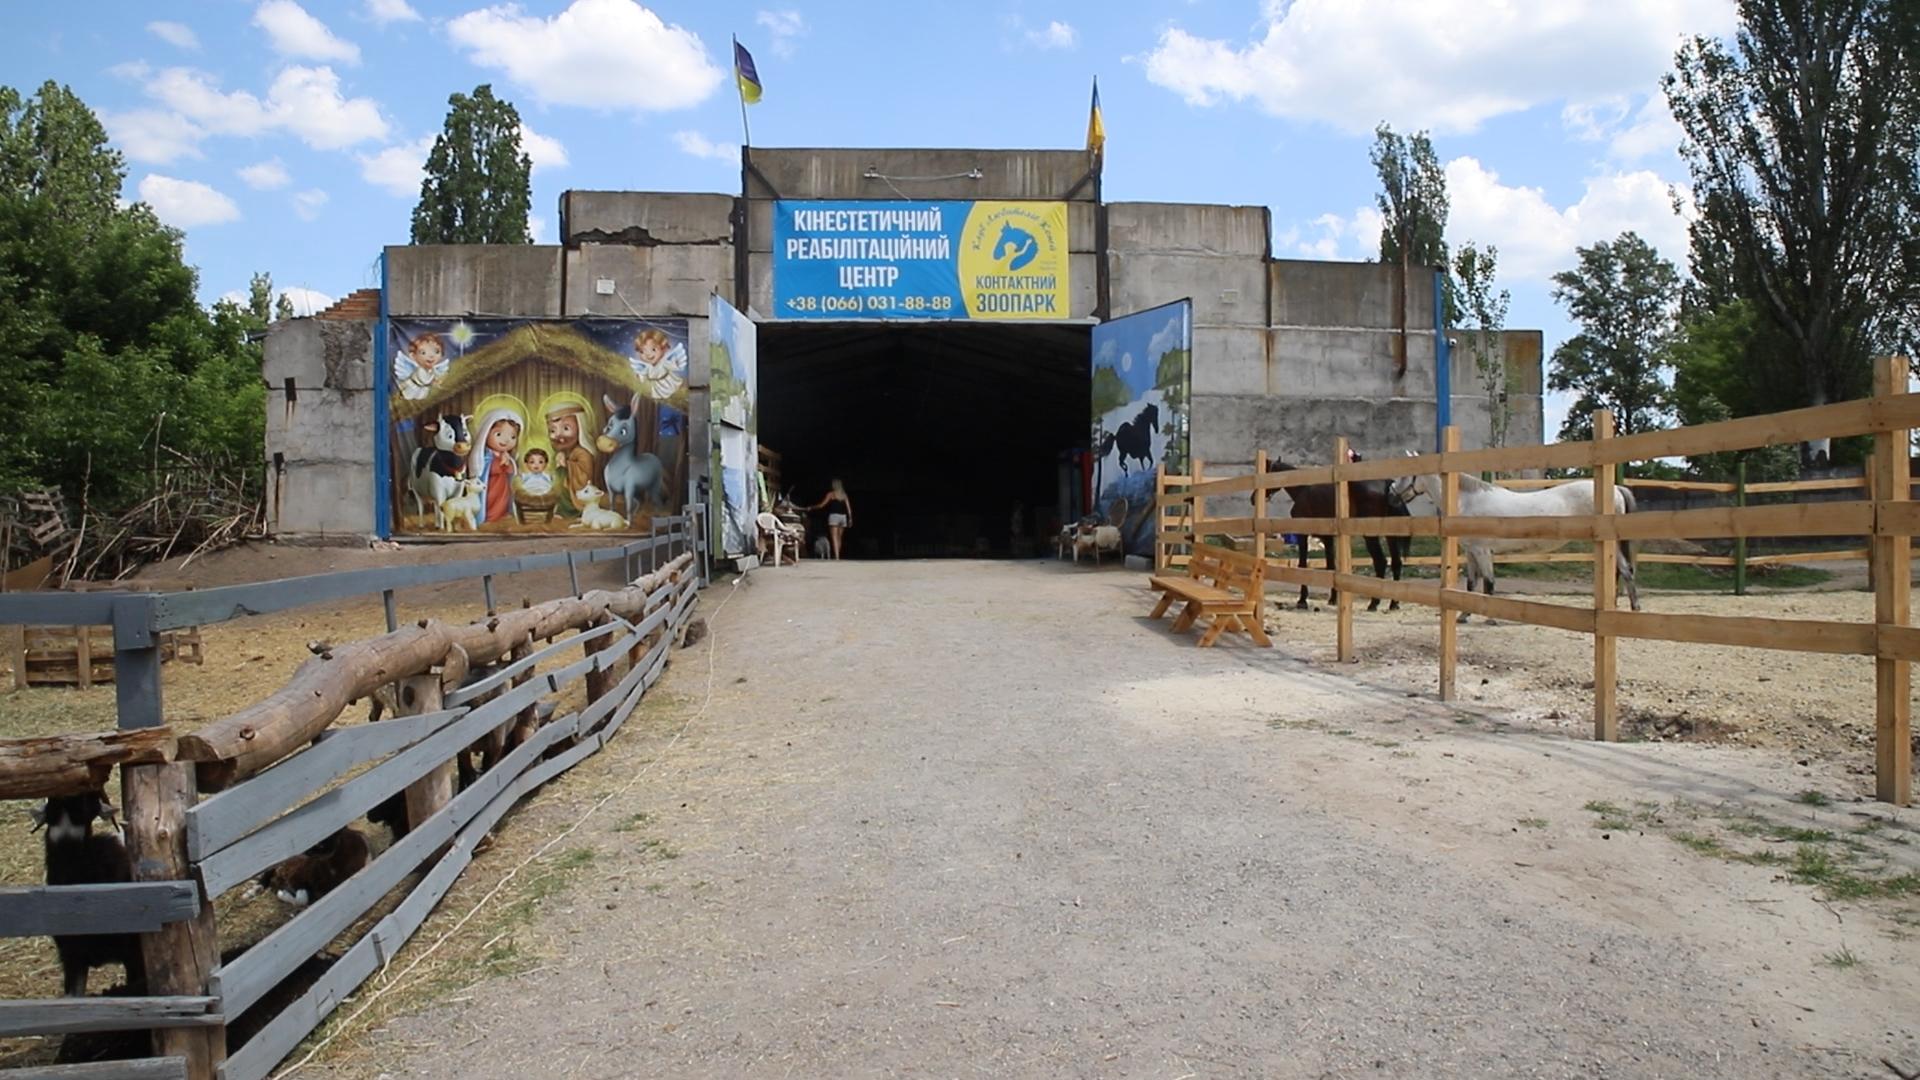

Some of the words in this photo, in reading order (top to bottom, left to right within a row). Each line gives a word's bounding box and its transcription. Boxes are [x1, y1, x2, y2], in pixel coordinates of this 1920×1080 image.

[794, 206, 942, 232] КІНЕСТЕТИЧНИЙ
[787, 234, 950, 261] РЕАБІЛІТАЦІЙНИЙ
[839, 266, 899, 290] ЦЕНТР
[976, 273, 1057, 289] КОНТАКТНИЙ
[786, 296, 816, 311] +38
[821, 295, 863, 313] (066)
[868, 296, 952, 311] 031-88-88
[976, 293, 1056, 313] ЗООПАРК
